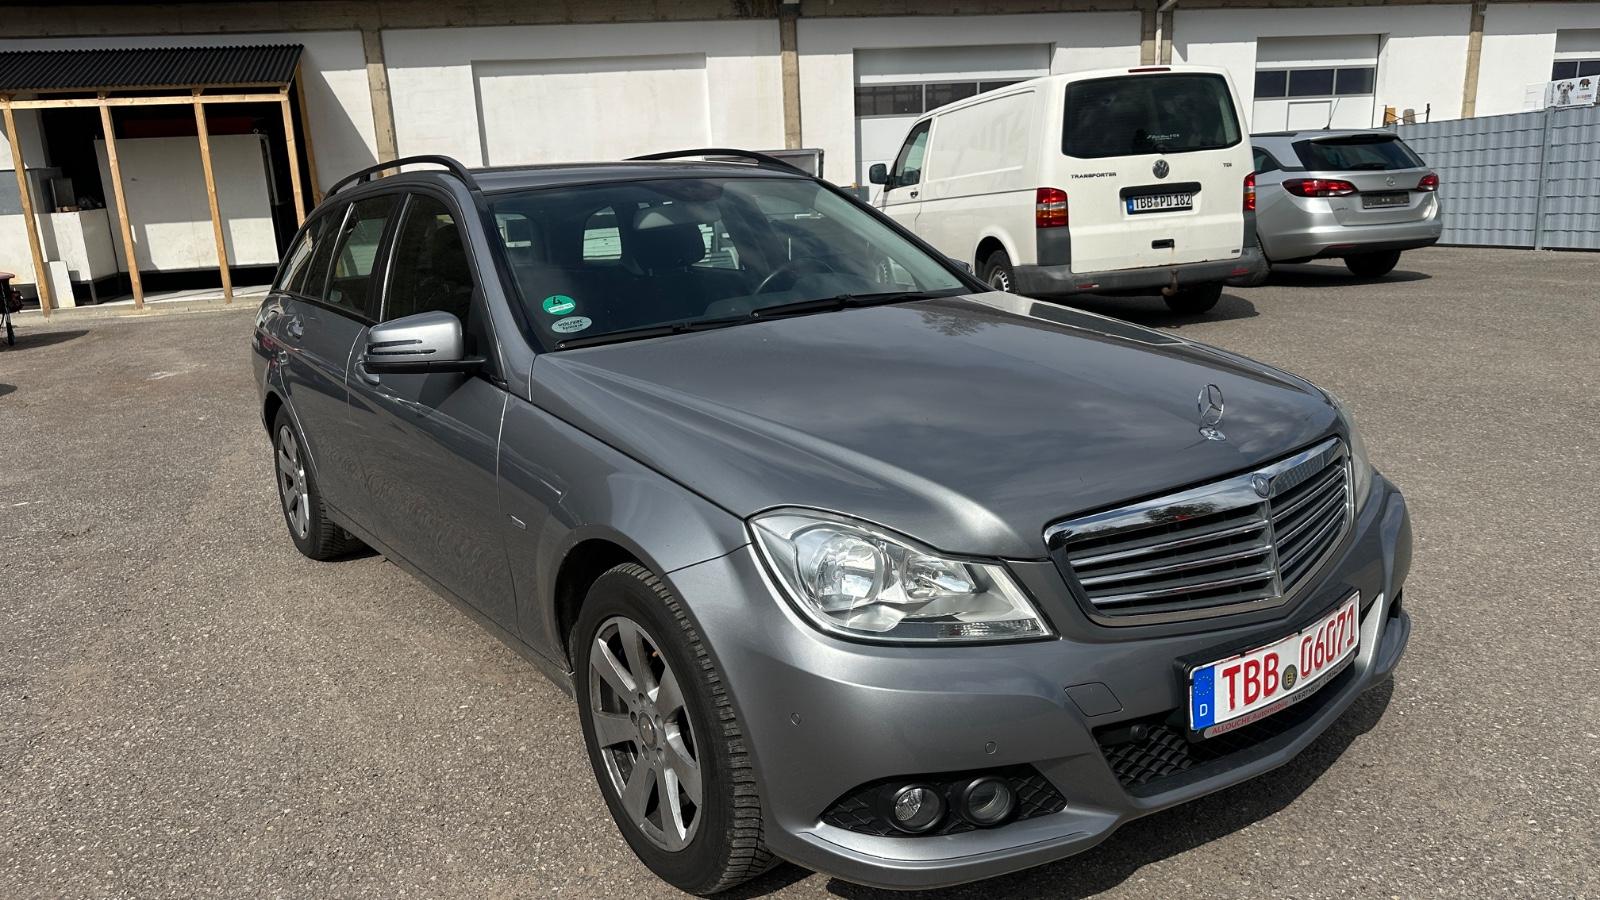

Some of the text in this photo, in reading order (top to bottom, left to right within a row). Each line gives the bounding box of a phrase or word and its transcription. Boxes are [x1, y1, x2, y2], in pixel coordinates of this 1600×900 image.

[1135, 194, 1191, 209] TBB PD 182
[1222, 603, 1355, 712] TBB 06071
[1199, 703, 1208, 717] D
[1212, 715, 1251, 734] ALLOUCHE
